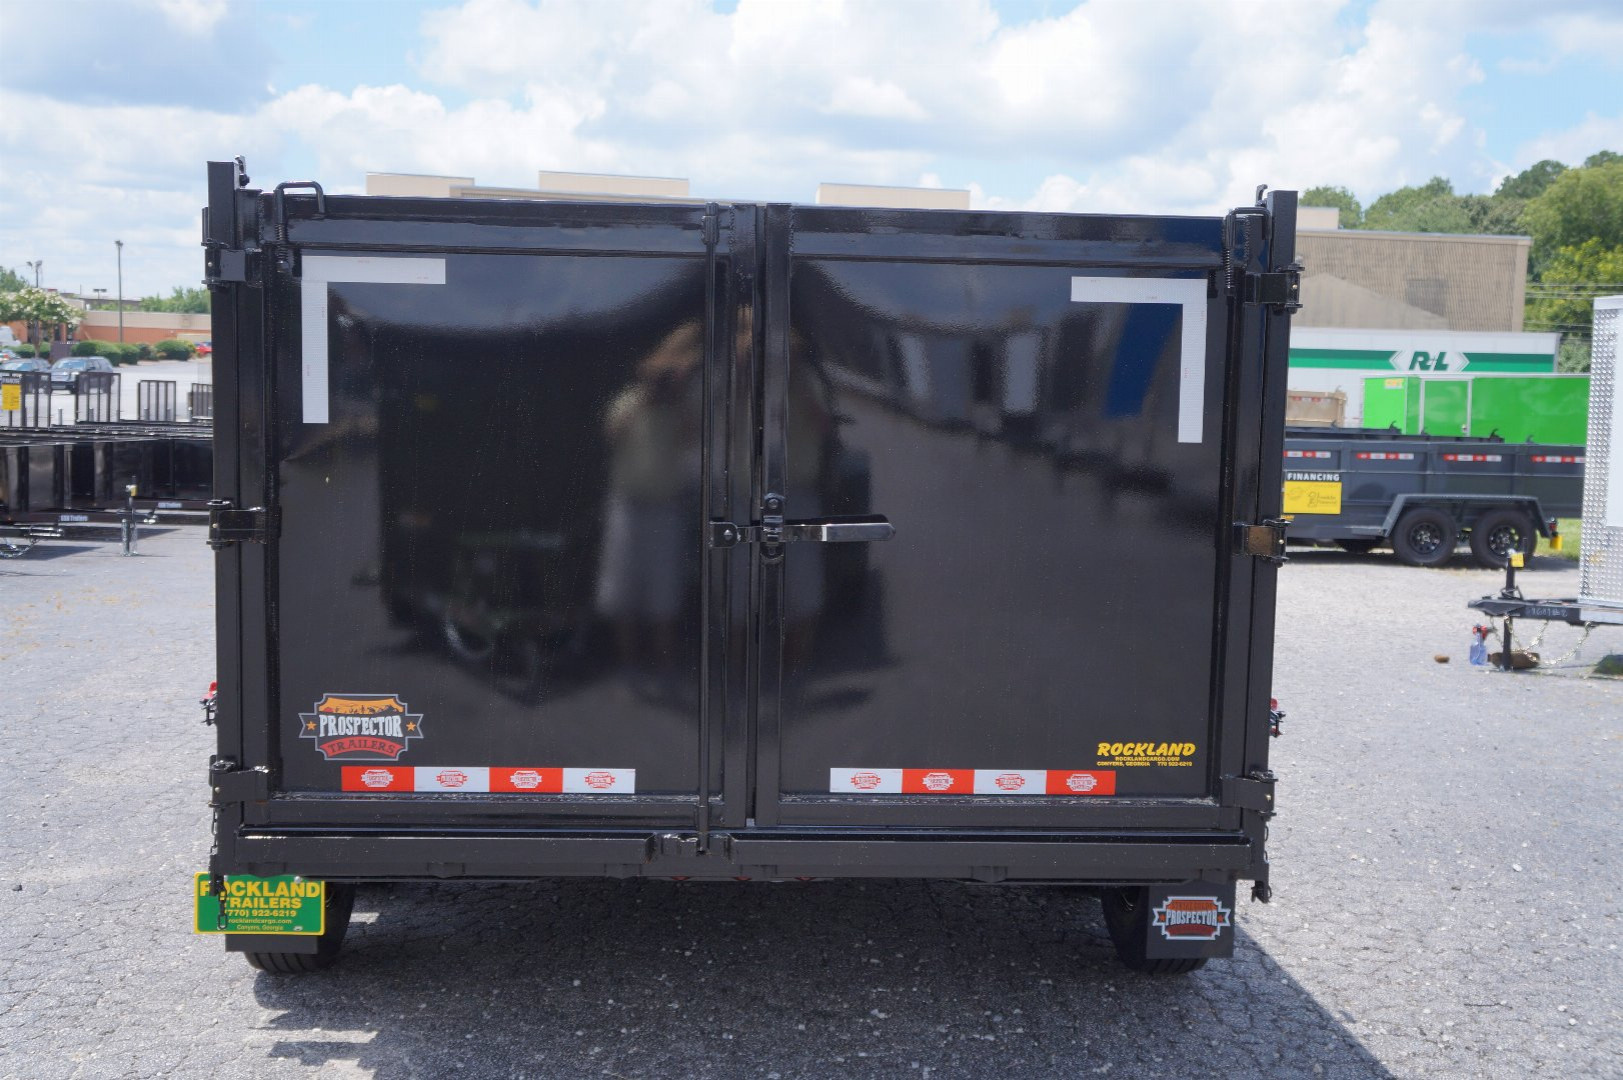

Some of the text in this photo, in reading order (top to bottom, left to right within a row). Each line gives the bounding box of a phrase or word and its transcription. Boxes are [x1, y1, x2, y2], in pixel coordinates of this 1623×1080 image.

[1287, 473, 1340, 481] FINANCING
[318, 715, 403, 737] PROSPECTOR
[328, 739, 396, 753] TRAILERS
[1097, 742, 1196, 757] ROCKLAND
[252, 909, 297, 917] 922-6219
[1165, 909, 1217, 926] PROSPECTOR
